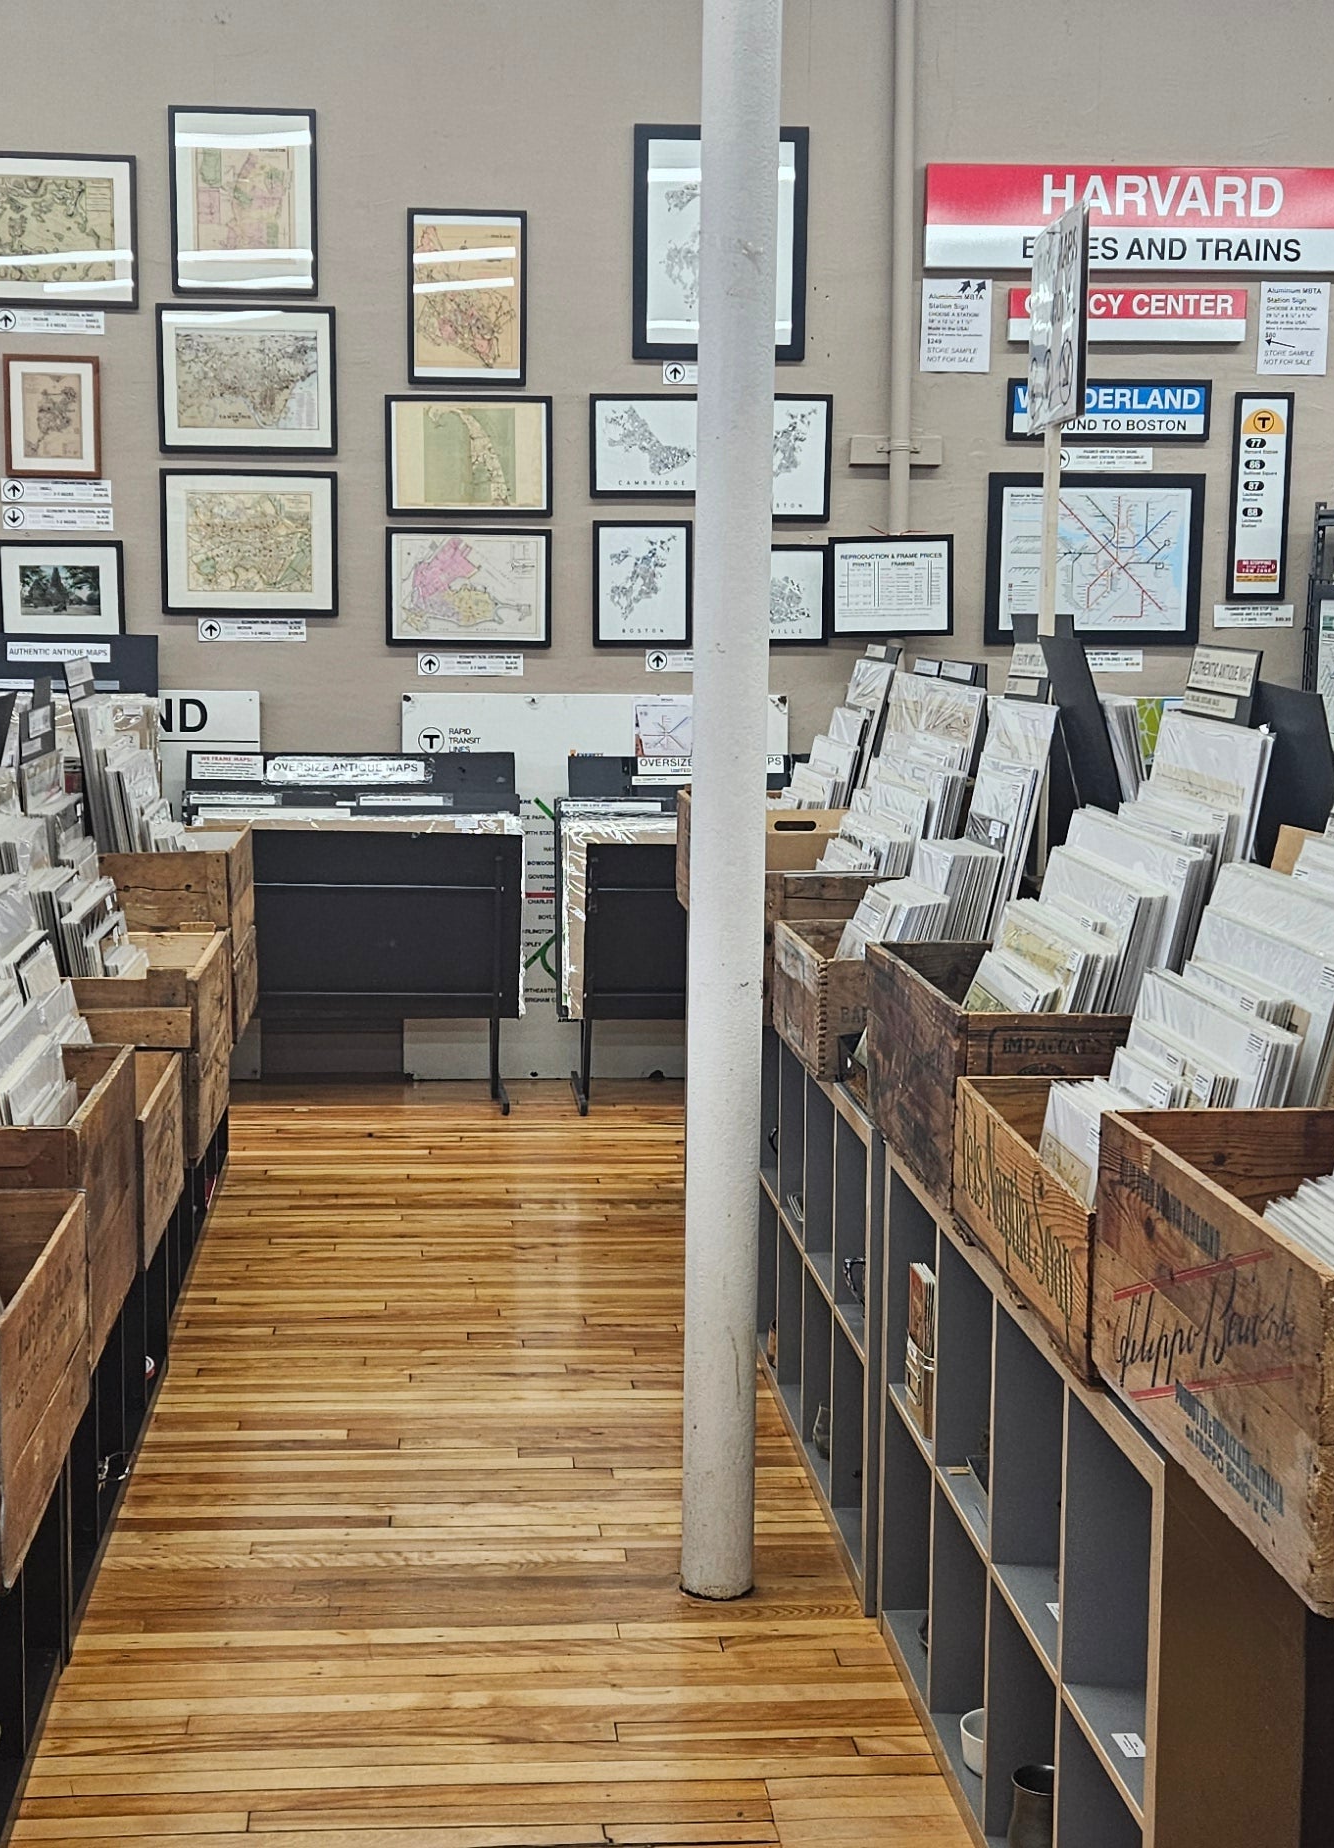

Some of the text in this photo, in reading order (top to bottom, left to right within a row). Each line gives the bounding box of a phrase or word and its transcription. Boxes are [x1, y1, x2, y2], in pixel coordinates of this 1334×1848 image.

[1042, 174, 1284, 218] HARVARD
[1126, 237, 1301, 262] AND TRAINS
[1132, 294, 1233, 315] CENTER
[1102, 419, 1121, 431] TO
[1126, 419, 1187, 431] BOSTON
